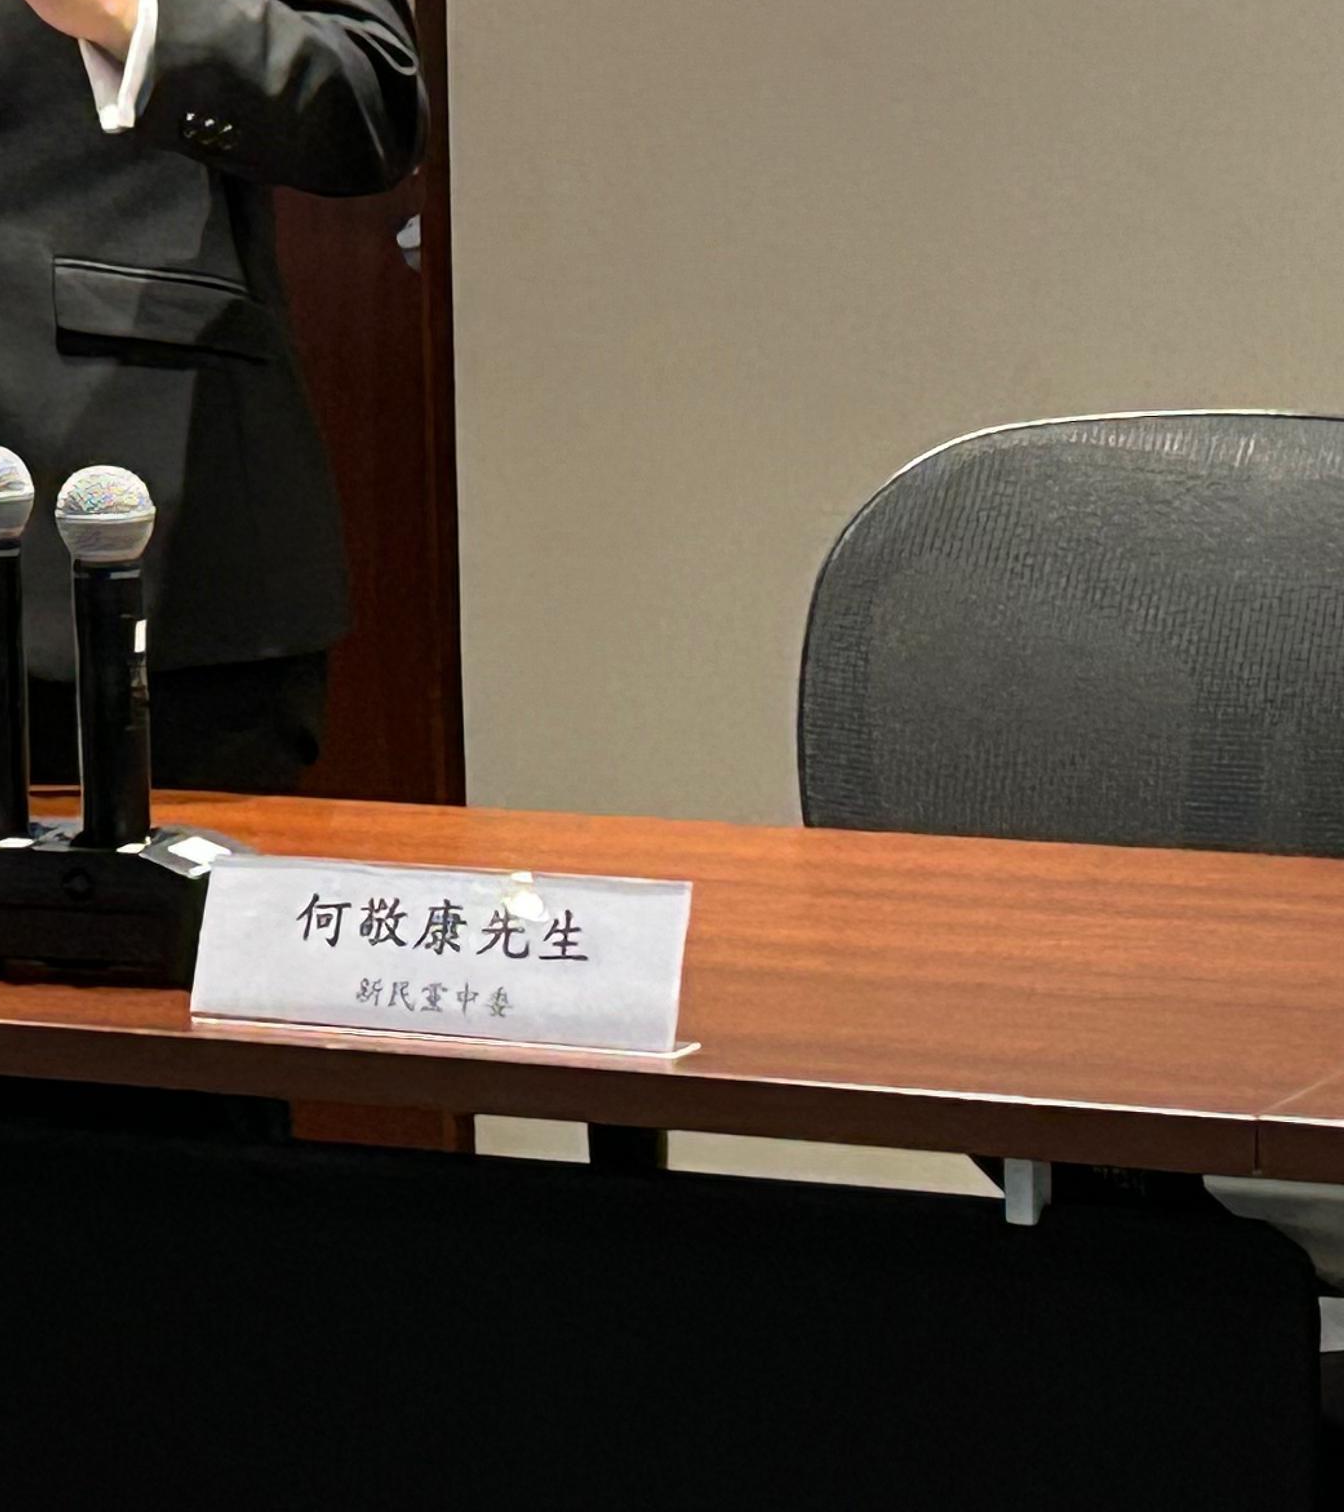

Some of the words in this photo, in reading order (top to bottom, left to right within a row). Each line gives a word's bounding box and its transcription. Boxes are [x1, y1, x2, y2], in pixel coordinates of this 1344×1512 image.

[295, 892, 590, 963] 何敬康先生
